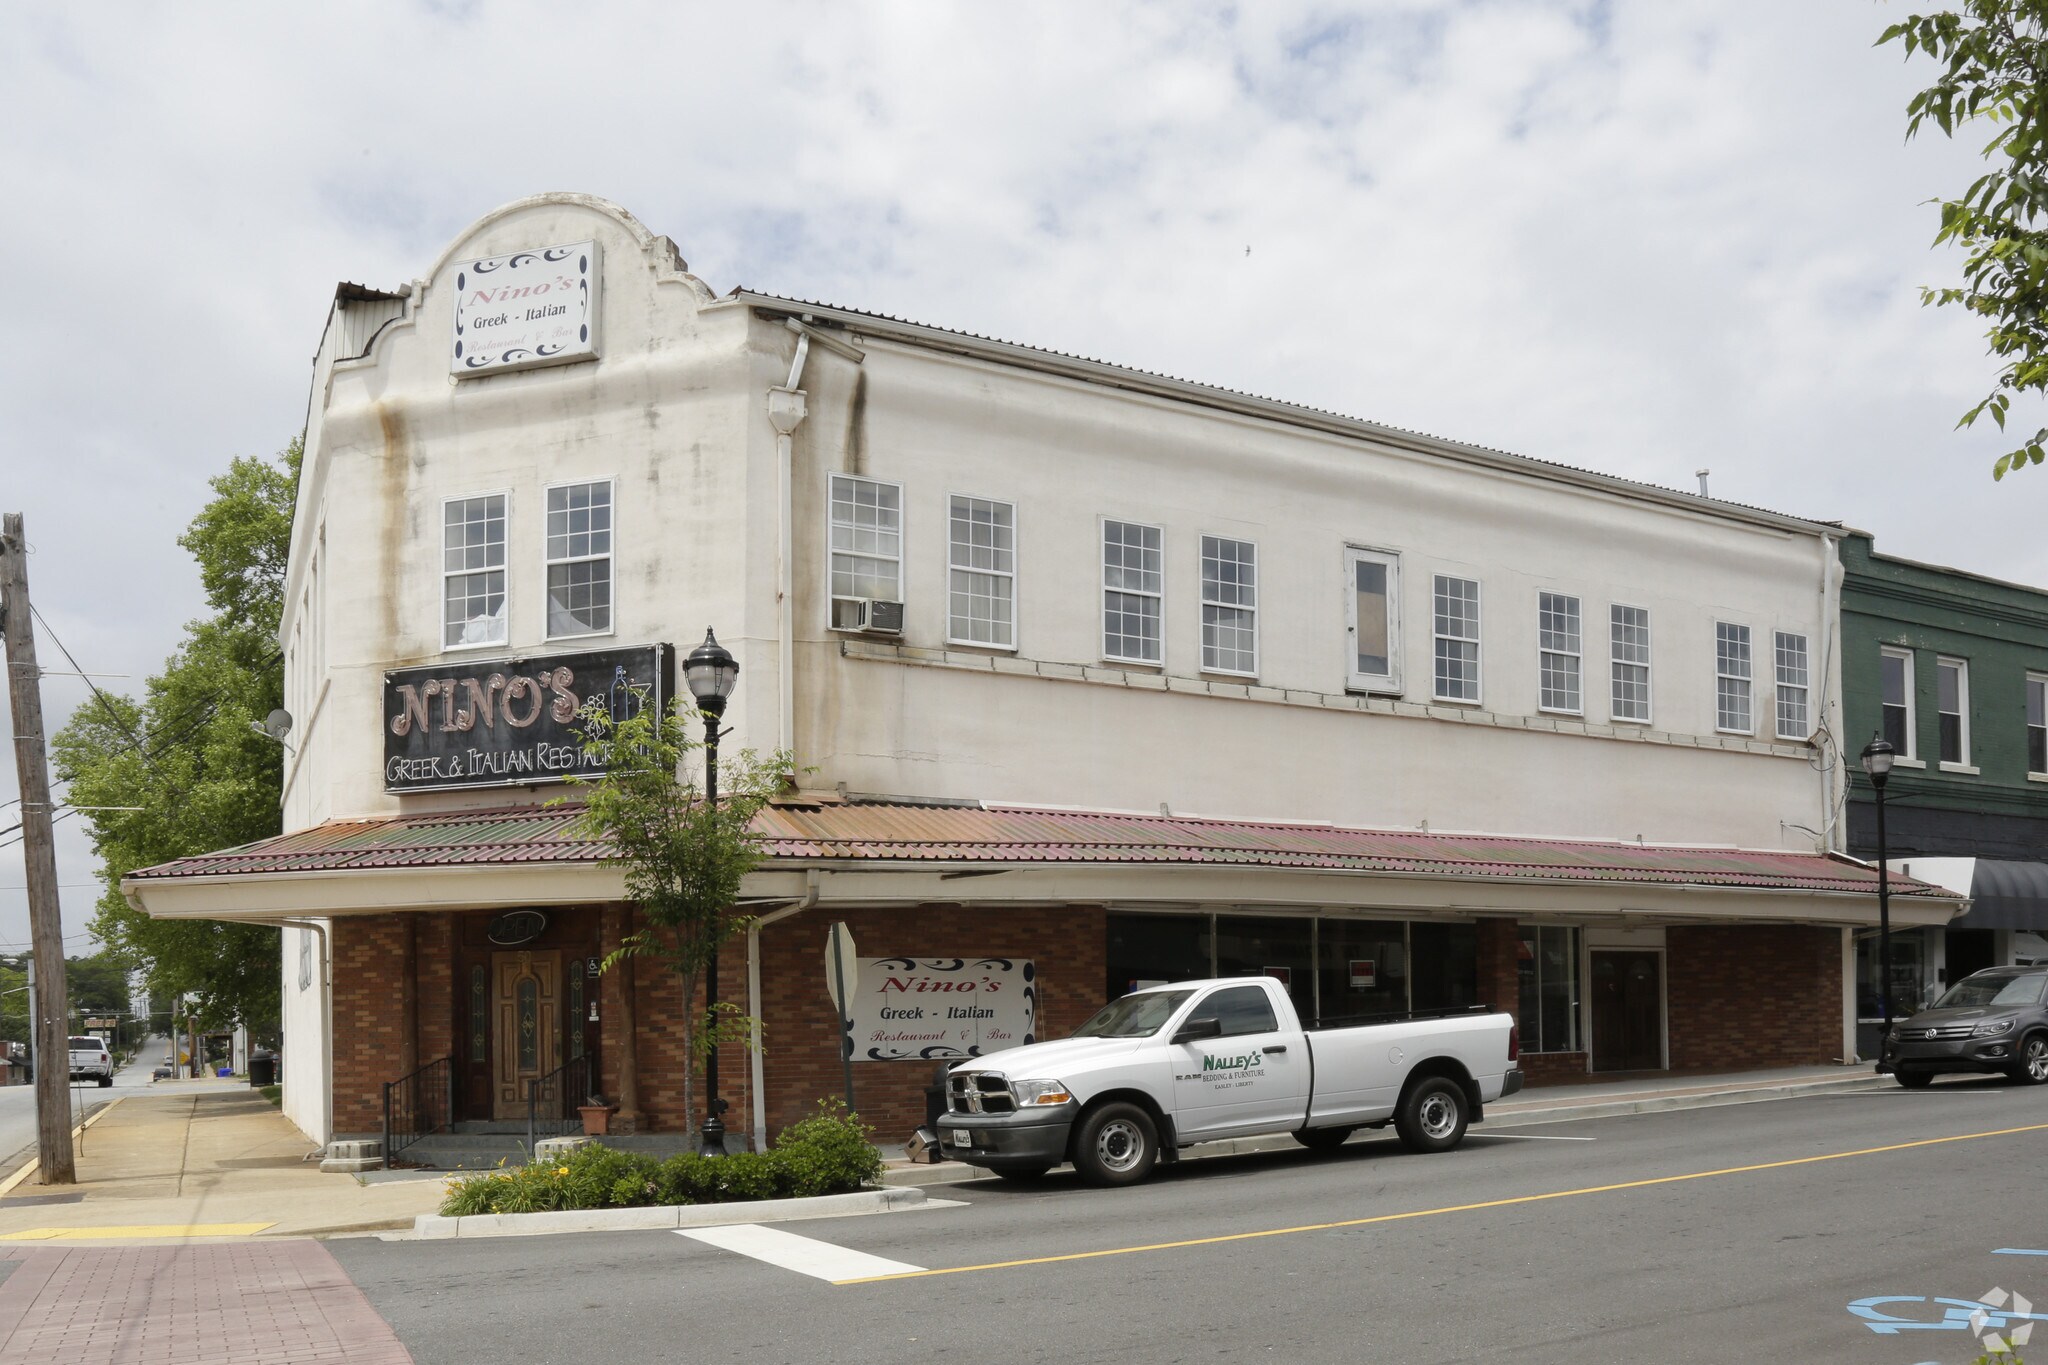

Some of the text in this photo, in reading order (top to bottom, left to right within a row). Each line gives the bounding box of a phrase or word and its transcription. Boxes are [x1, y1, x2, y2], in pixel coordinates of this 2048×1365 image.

[466, 275, 574, 307] Nino's
[473, 313, 508, 329] Greek
[525, 304, 566, 321] Italian
[466, 334, 527, 353] Restaurant
[551, 326, 573, 339] Bar
[390, 665, 579, 737] NINO'S
[386, 755, 448, 783] GREEK
[449, 755, 464, 777] &
[466, 748, 534, 778] ITALIAN
[876, 976, 1002, 993] Nino's
[880, 1006, 924, 1019] Greek
[947, 1005, 994, 1019] Italian
[870, 1030, 946, 1041] Restaurant
[986, 1028, 1012, 1040] Bar
[1202, 1073, 1227, 1082] BEDDING
[1234, 1069, 1265, 1079] FURNITURE
